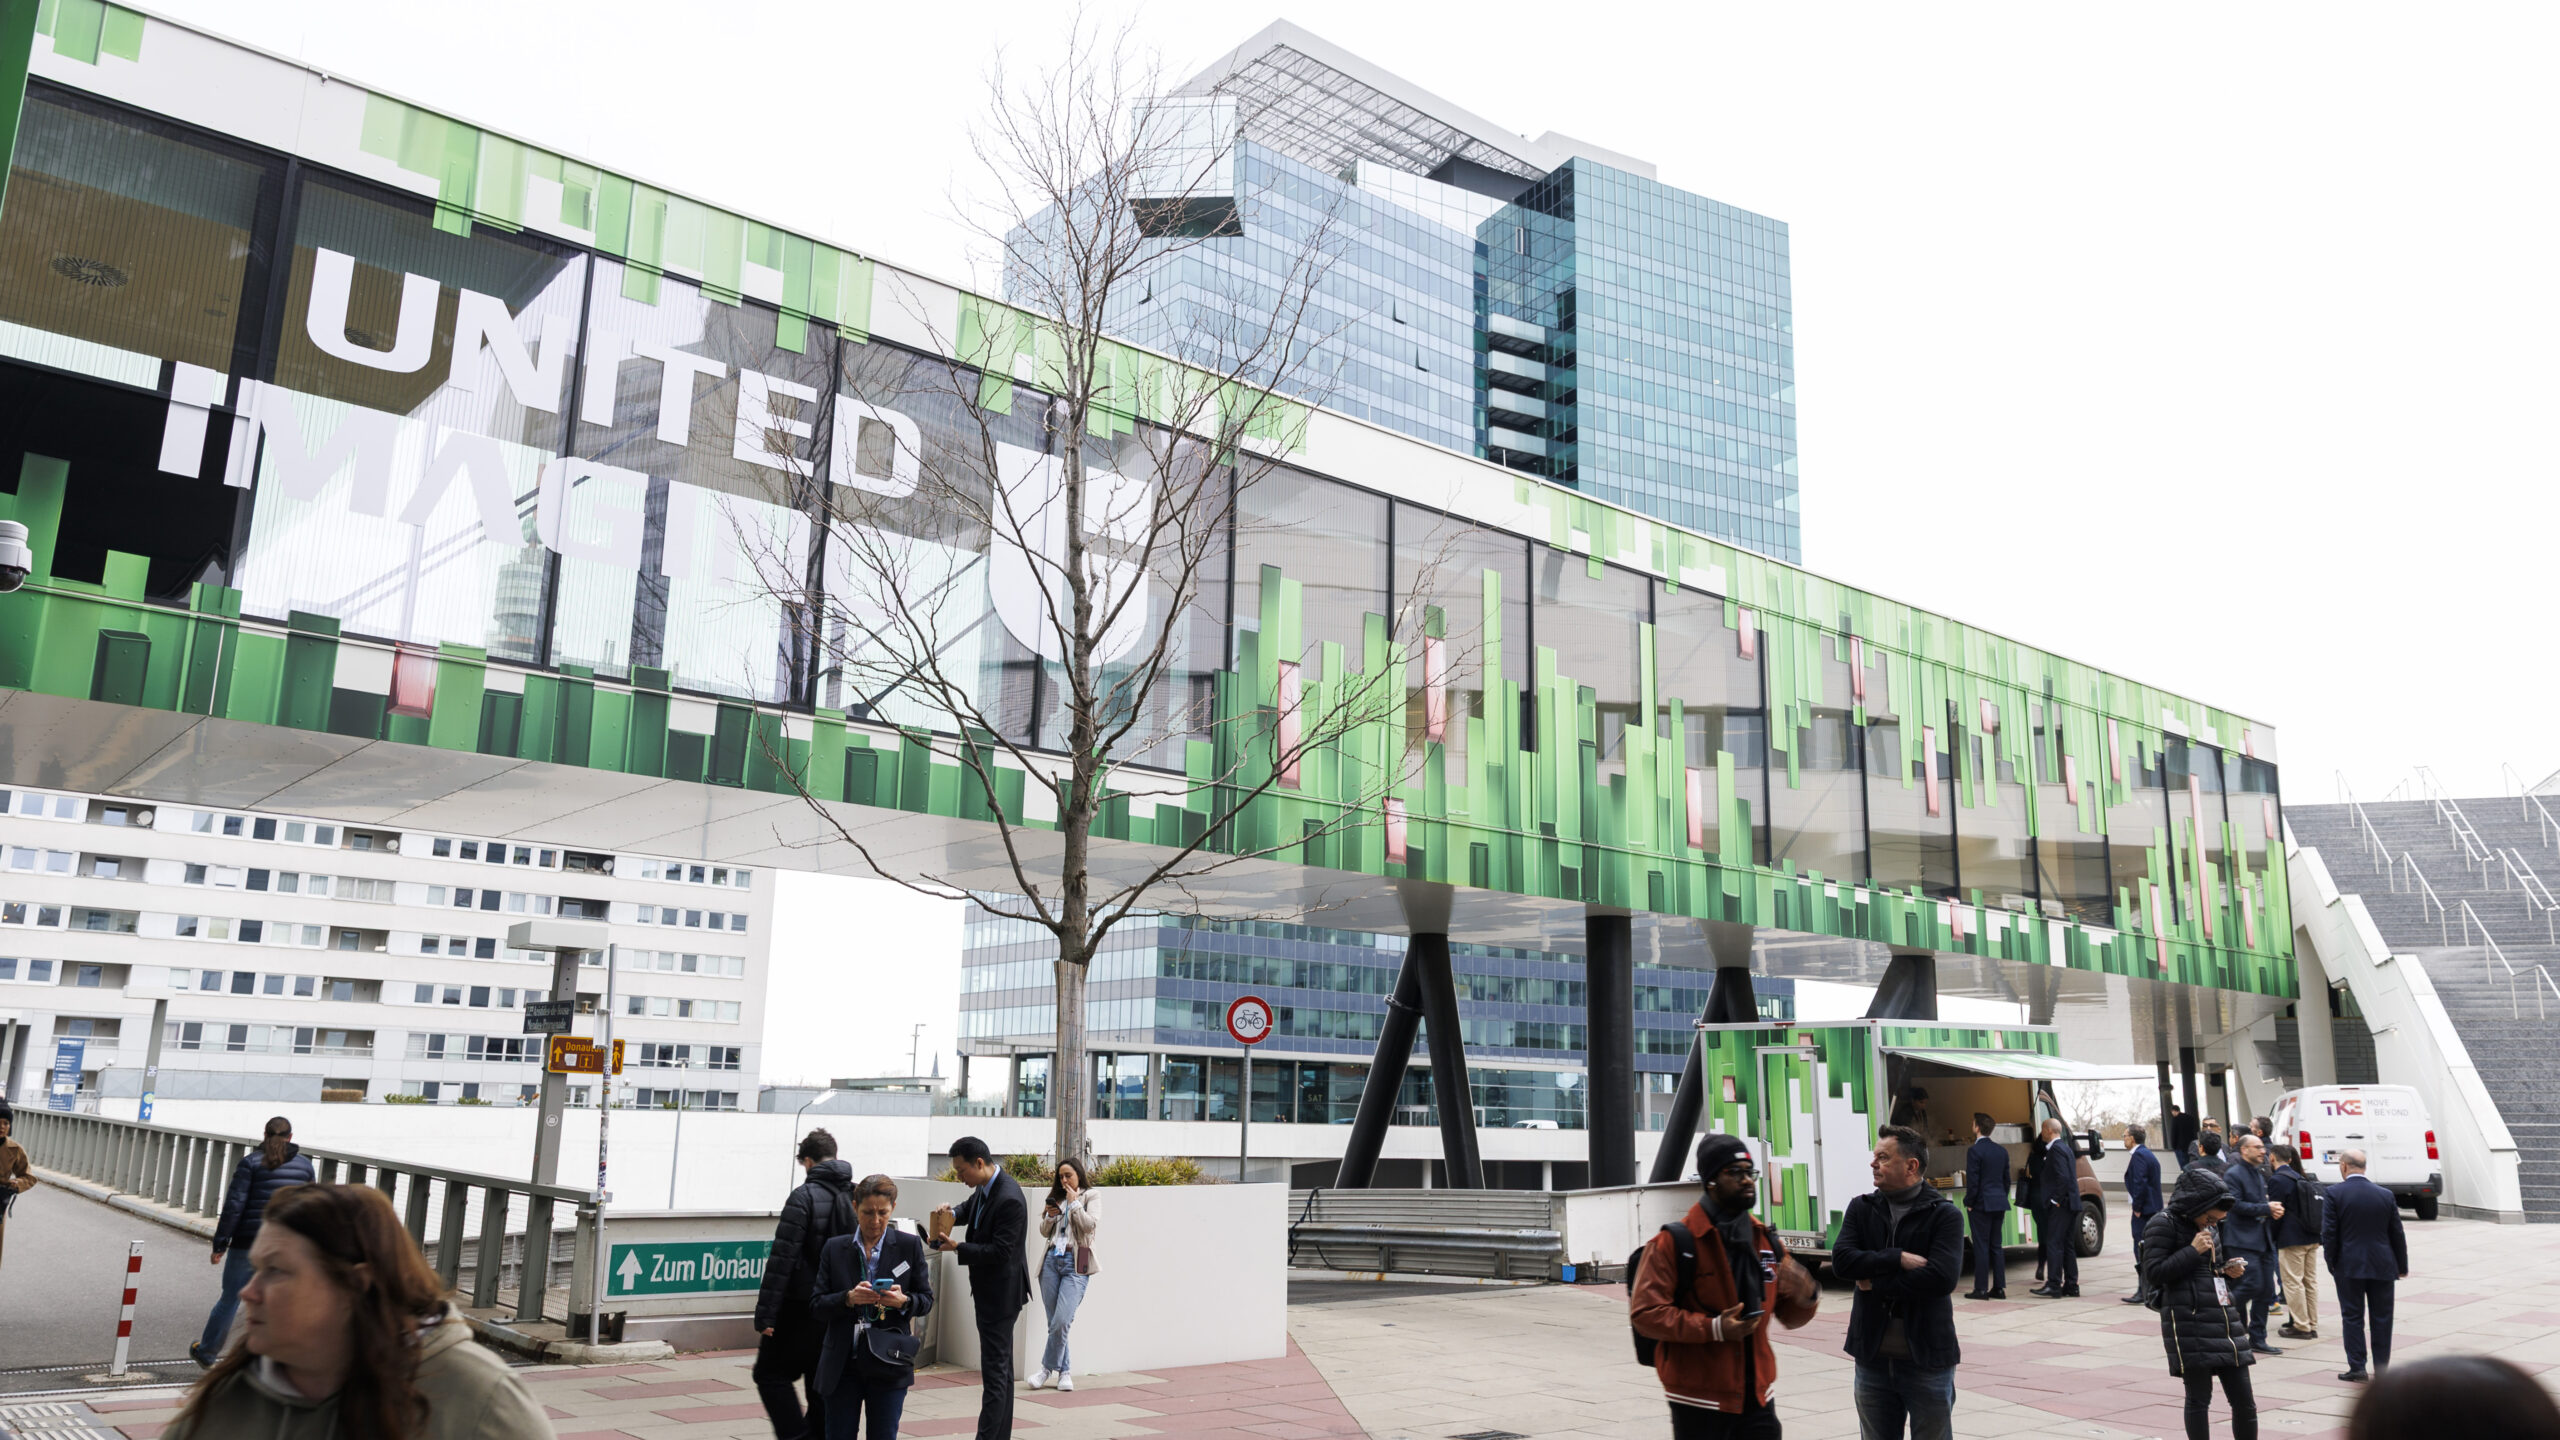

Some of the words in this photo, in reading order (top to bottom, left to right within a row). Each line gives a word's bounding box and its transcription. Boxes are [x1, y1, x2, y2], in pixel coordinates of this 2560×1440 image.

[306, 247, 921, 499] UNITED
[158, 360, 915, 622] IMAGING
[2320, 1100, 2363, 1116] TKE
[2367, 1099, 2390, 1107] MOVE
[650, 1254, 695, 1282] Zum
